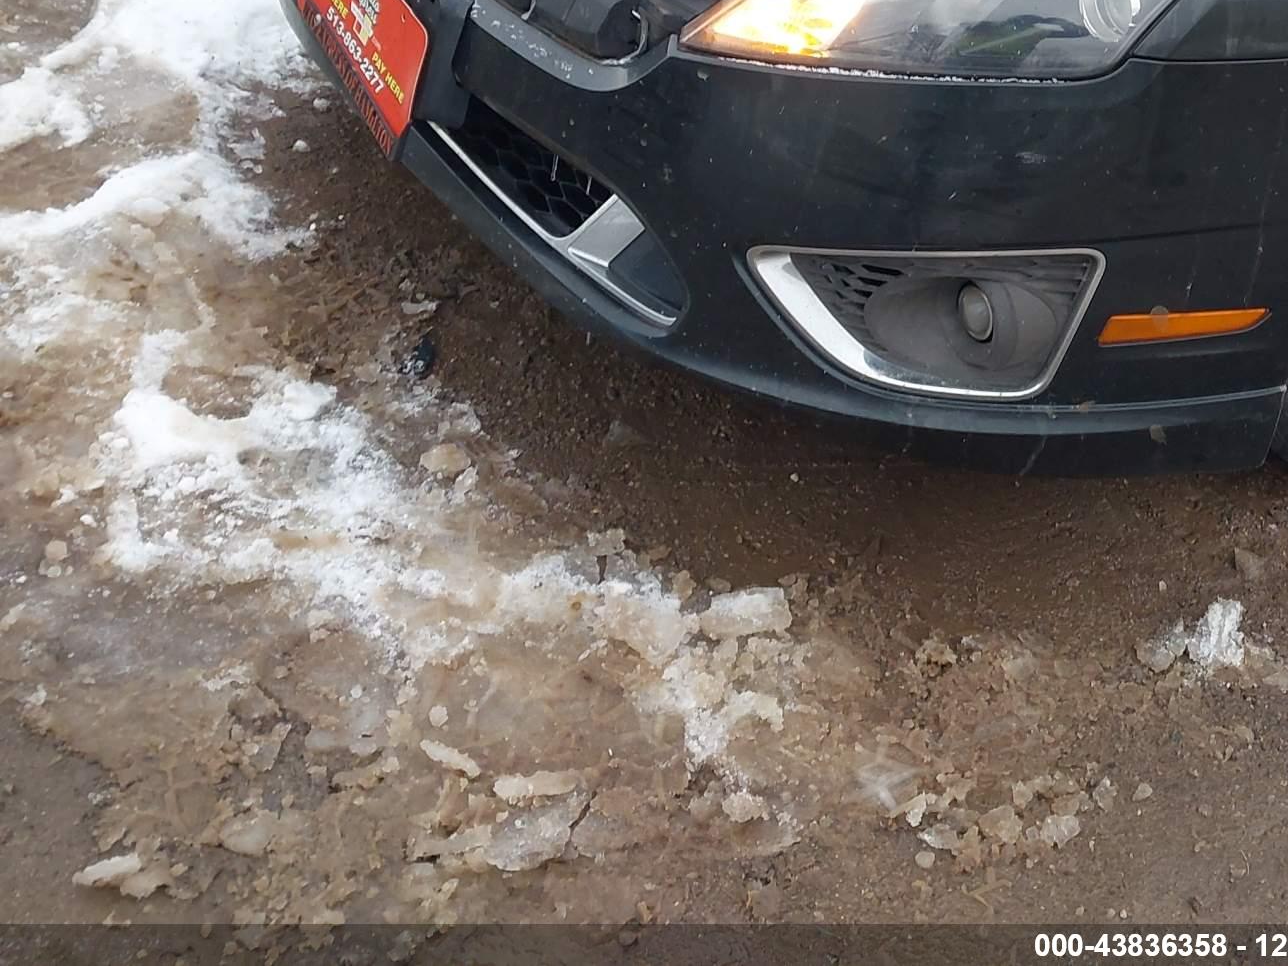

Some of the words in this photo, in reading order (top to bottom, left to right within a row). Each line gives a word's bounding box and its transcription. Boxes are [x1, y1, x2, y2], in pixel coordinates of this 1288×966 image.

[327, 6, 384, 94] 513-863-2277
[372, 51, 387, 75] PAY
[385, 72, 405, 105] HERE
